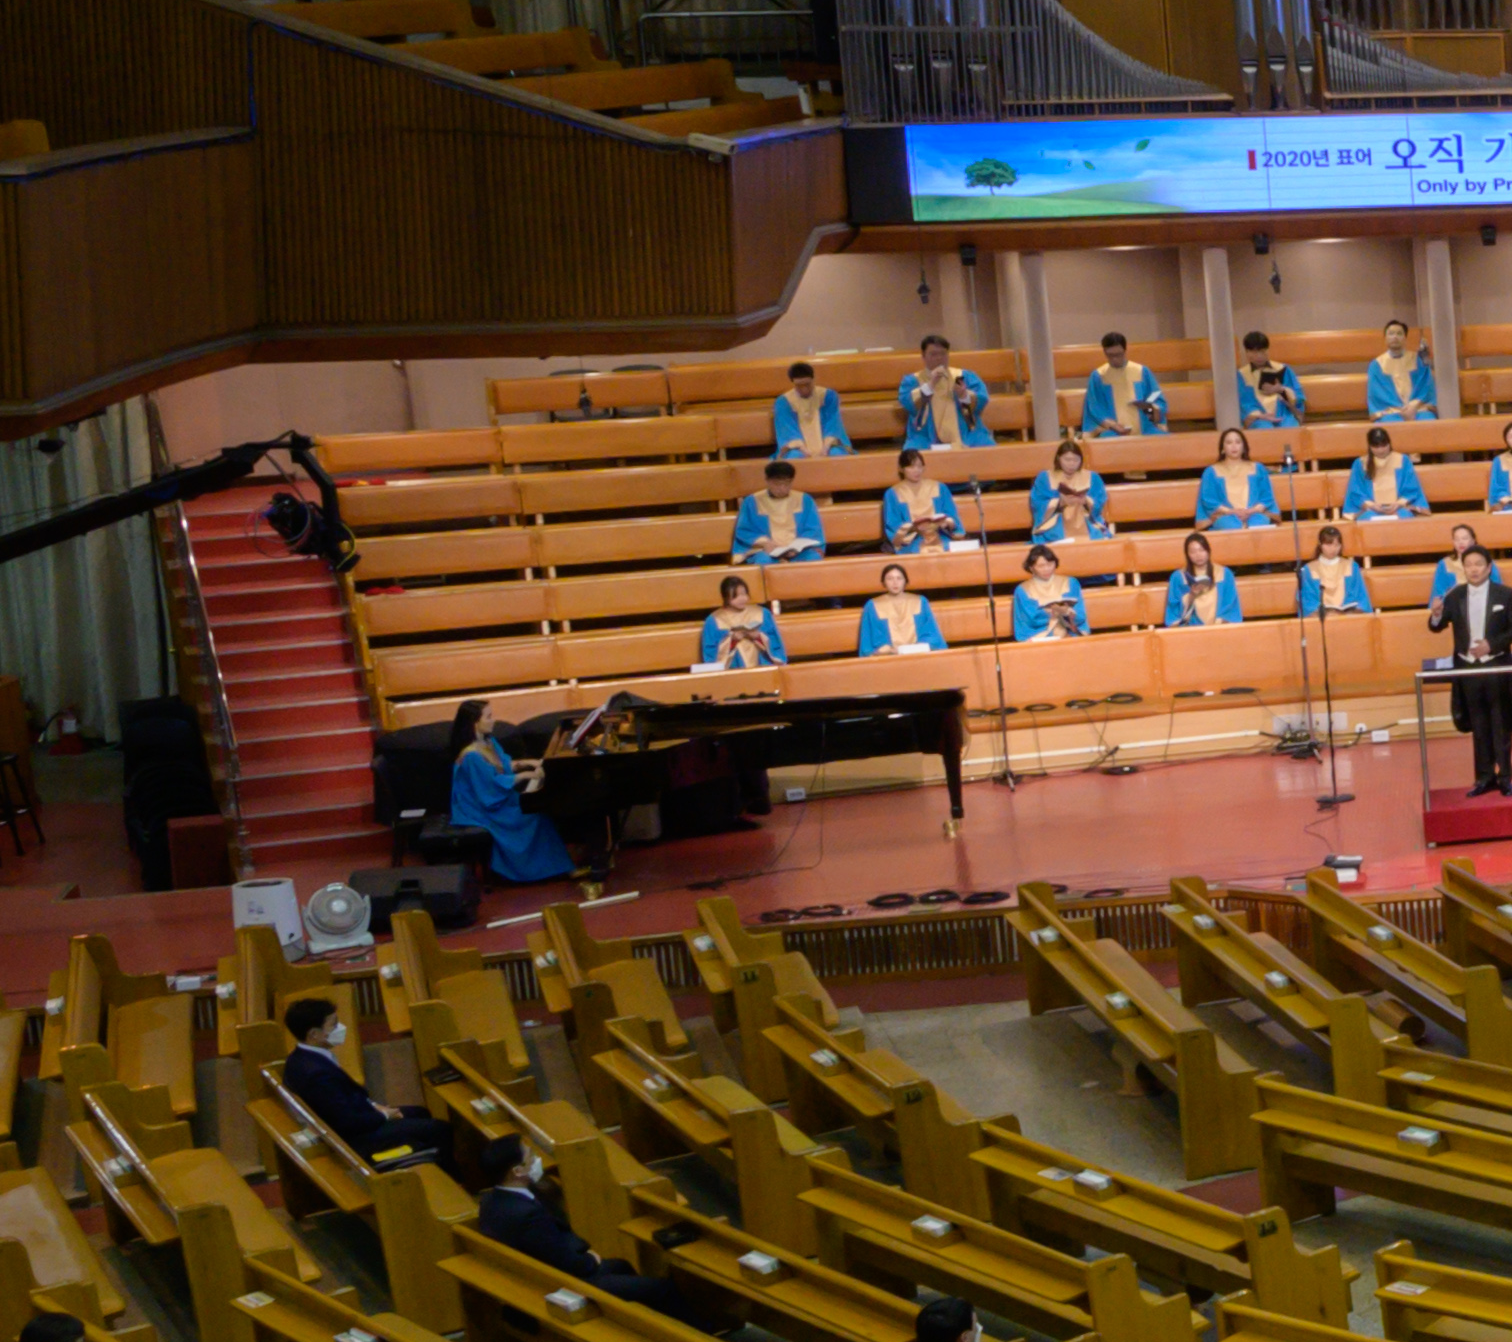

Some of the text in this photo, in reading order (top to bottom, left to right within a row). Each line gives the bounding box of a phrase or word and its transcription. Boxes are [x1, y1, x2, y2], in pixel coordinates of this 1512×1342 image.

[1262, 149, 1330, 168] 2020년
[1336, 148, 1372, 166] 표어
[1384, 133, 1464, 175] 오직
[1417, 180, 1459, 195] Only
[1465, 178, 1487, 194] by
